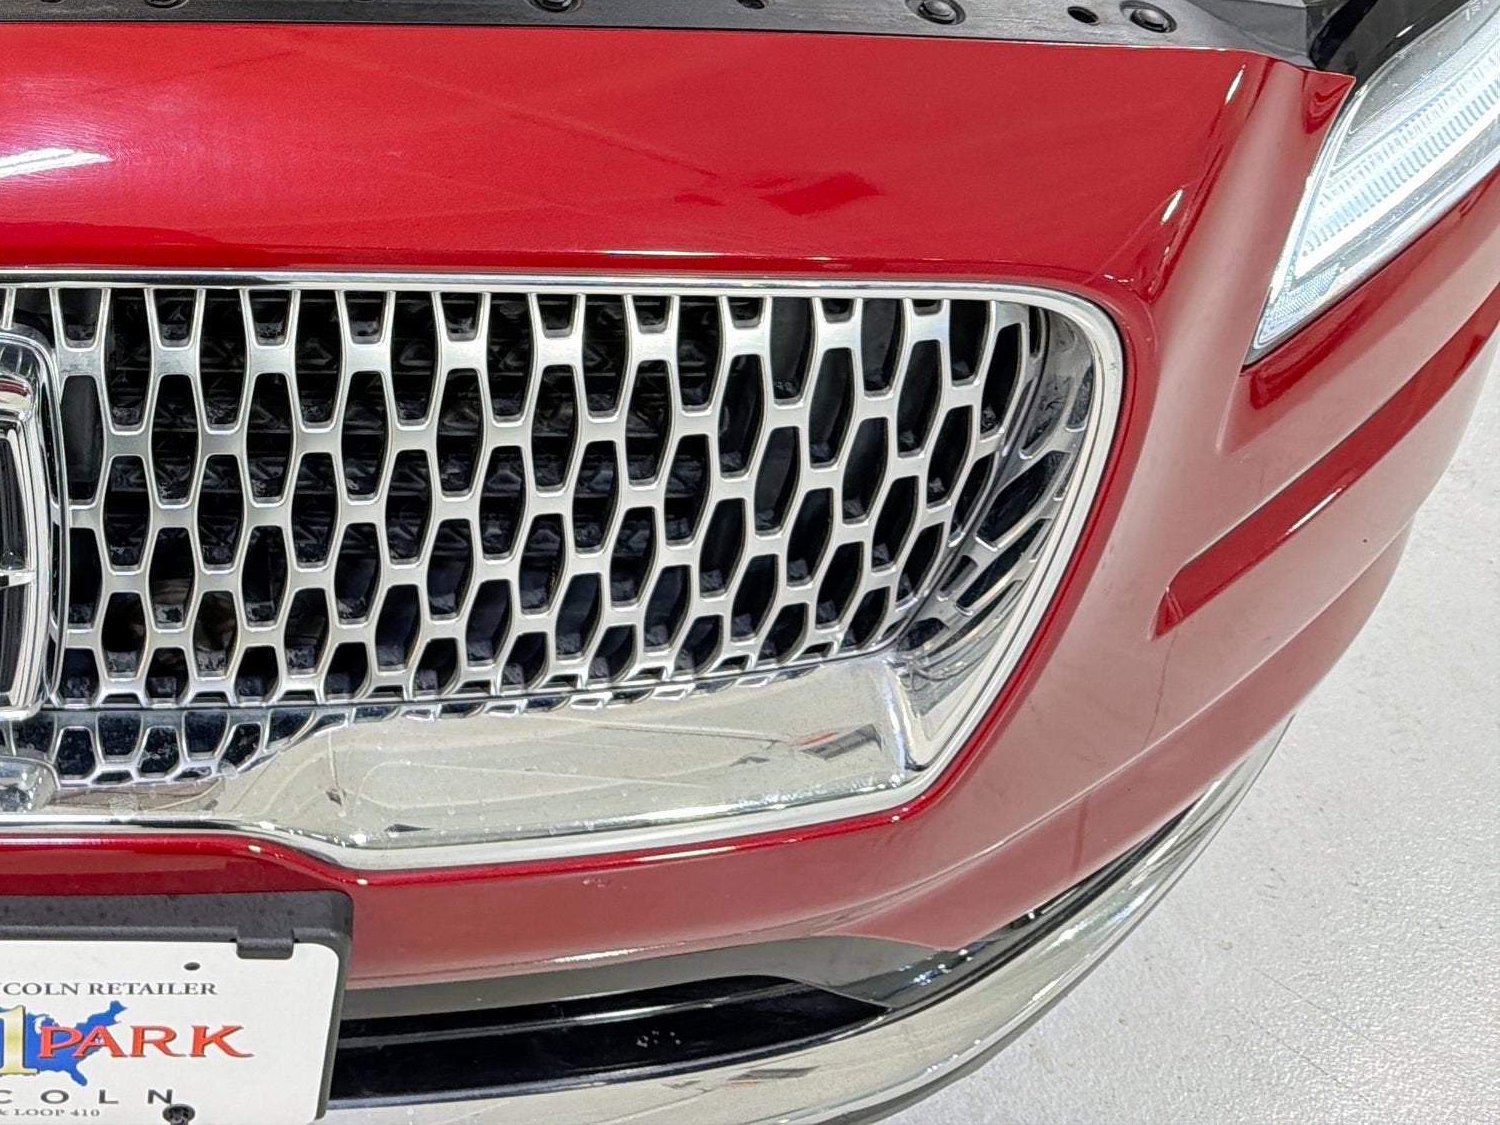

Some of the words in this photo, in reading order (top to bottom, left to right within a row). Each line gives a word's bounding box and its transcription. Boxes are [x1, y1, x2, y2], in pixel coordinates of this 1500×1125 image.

[87, 982, 219, 996] RETAILER
[38, 1024, 255, 1059] PARK
[14, 1108, 66, 1117] LOOP
[70, 1108, 101, 1117] 410
